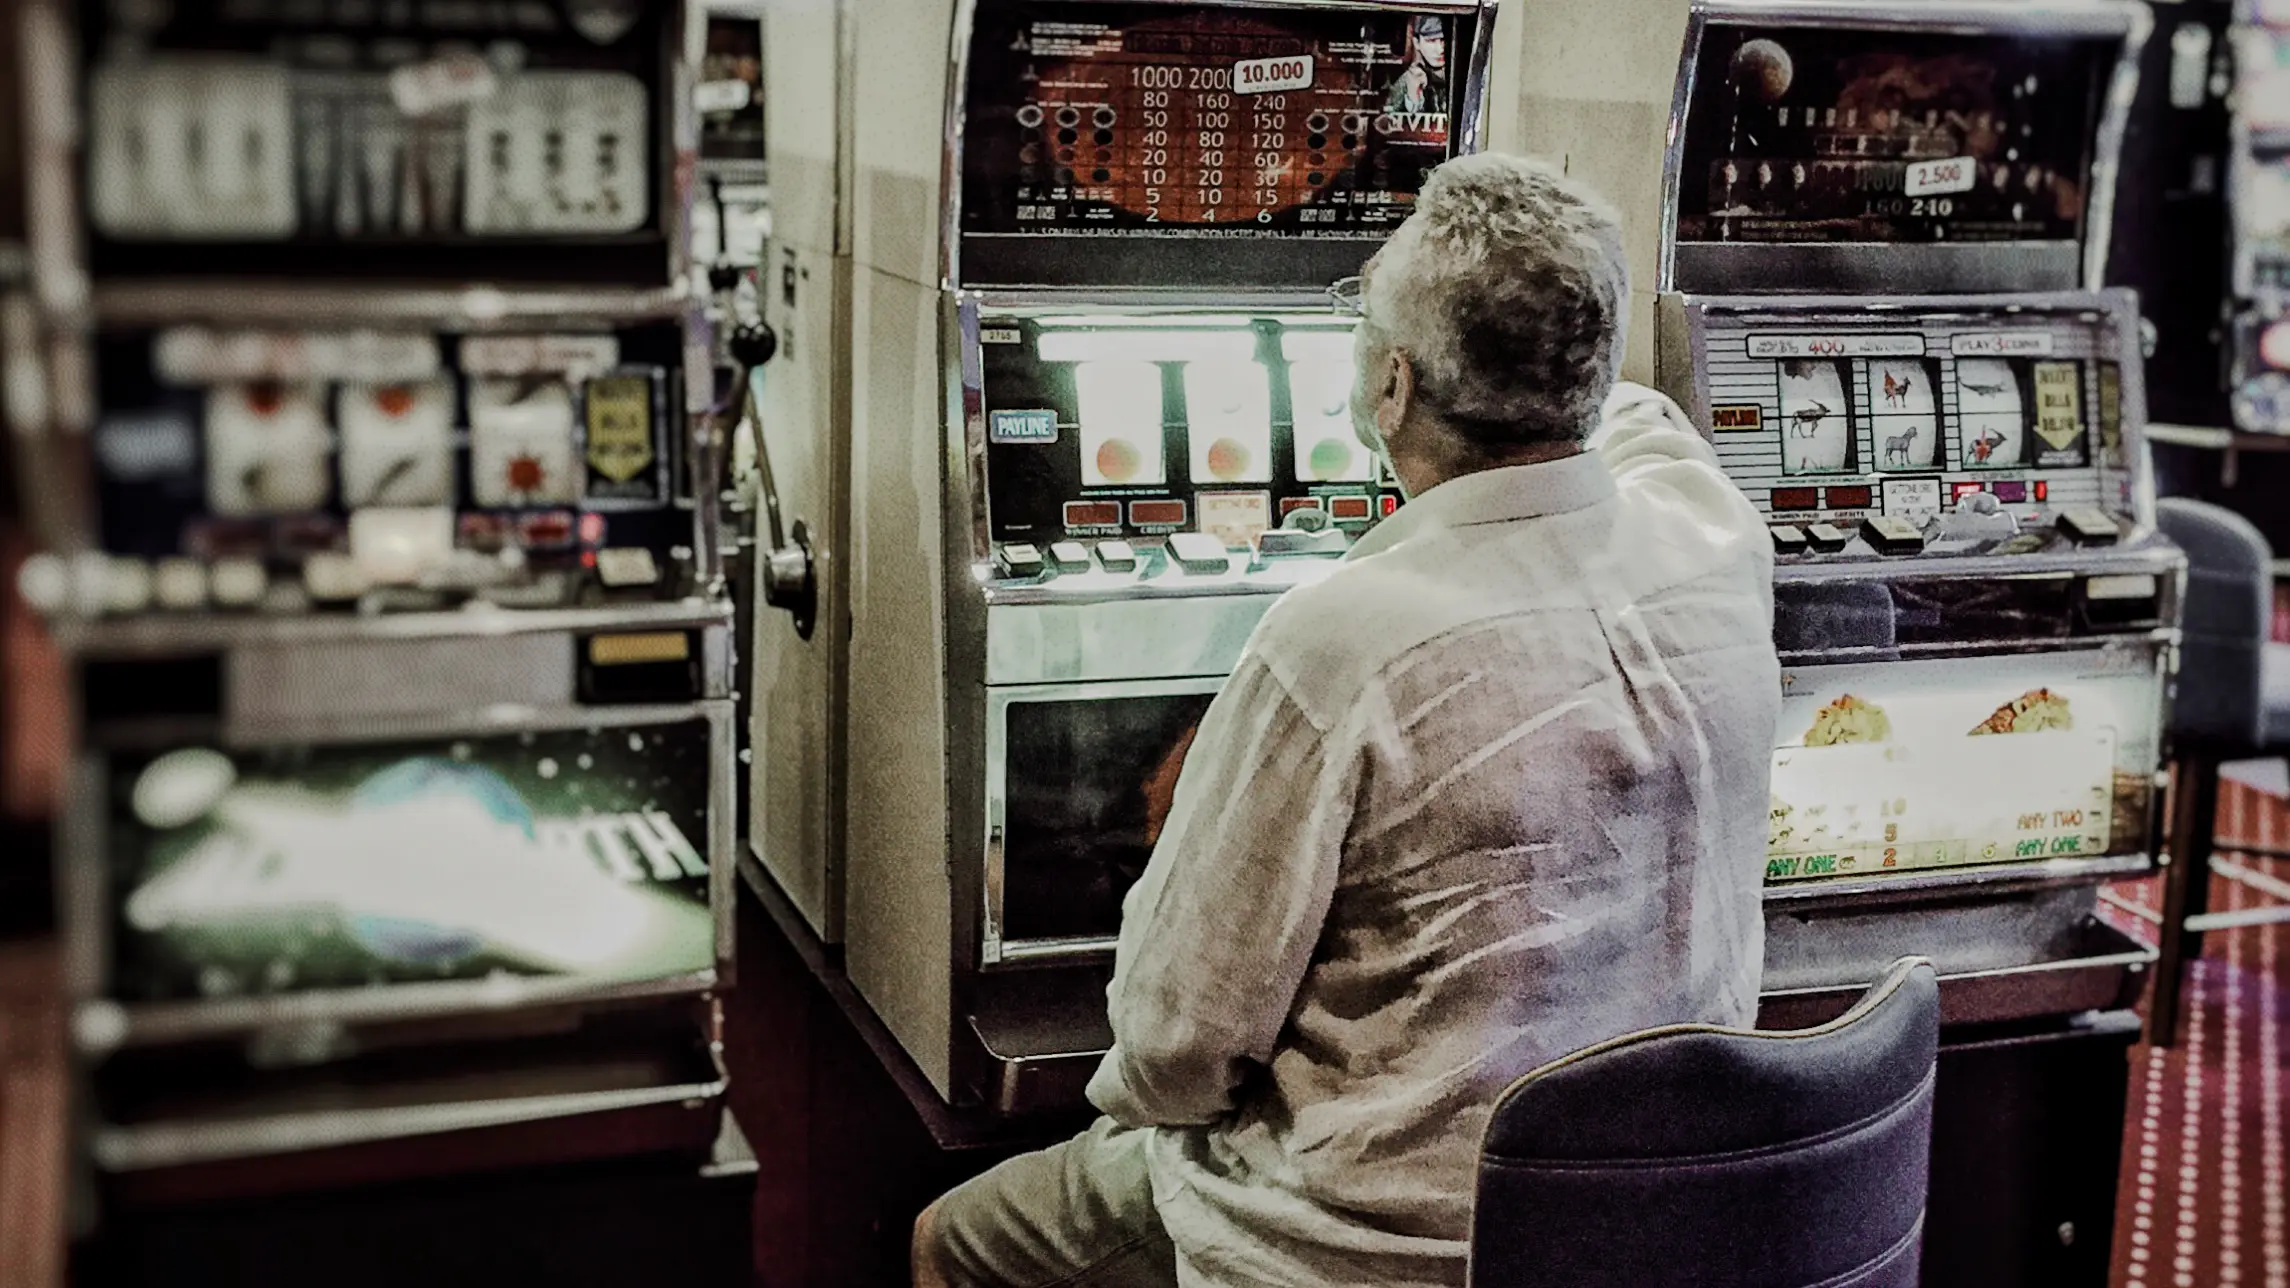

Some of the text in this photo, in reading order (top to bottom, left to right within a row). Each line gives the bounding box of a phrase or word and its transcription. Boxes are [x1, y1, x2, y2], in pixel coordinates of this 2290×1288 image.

[1132, 66, 1182, 89] 1000
[1243, 61, 1304, 84] 10.000
[1143, 91, 1286, 111] 80 160 240
[1144, 110, 1286, 129] 50 100 150
[1143, 130, 1285, 149] 40 80 120
[1142, 149, 1280, 168] 20 40 60
[1142, 168, 1167, 185] 10
[1198, 170, 1223, 186] 20
[1918, 164, 1961, 186] 2.500
[1146, 188, 1278, 206] 5 10 15
[1146, 208, 1272, 223] 2 4 6
[1910, 198, 1953, 217] 240
[1808, 340, 1845, 355] 400
[997, 416, 1051, 436] PAYLINE
[2017, 809, 2084, 831] ANY TWO
[2015, 834, 2082, 858] ANY ONE
[1766, 854, 1838, 878] ANY ONE
[1882, 847, 1898, 867] 2
